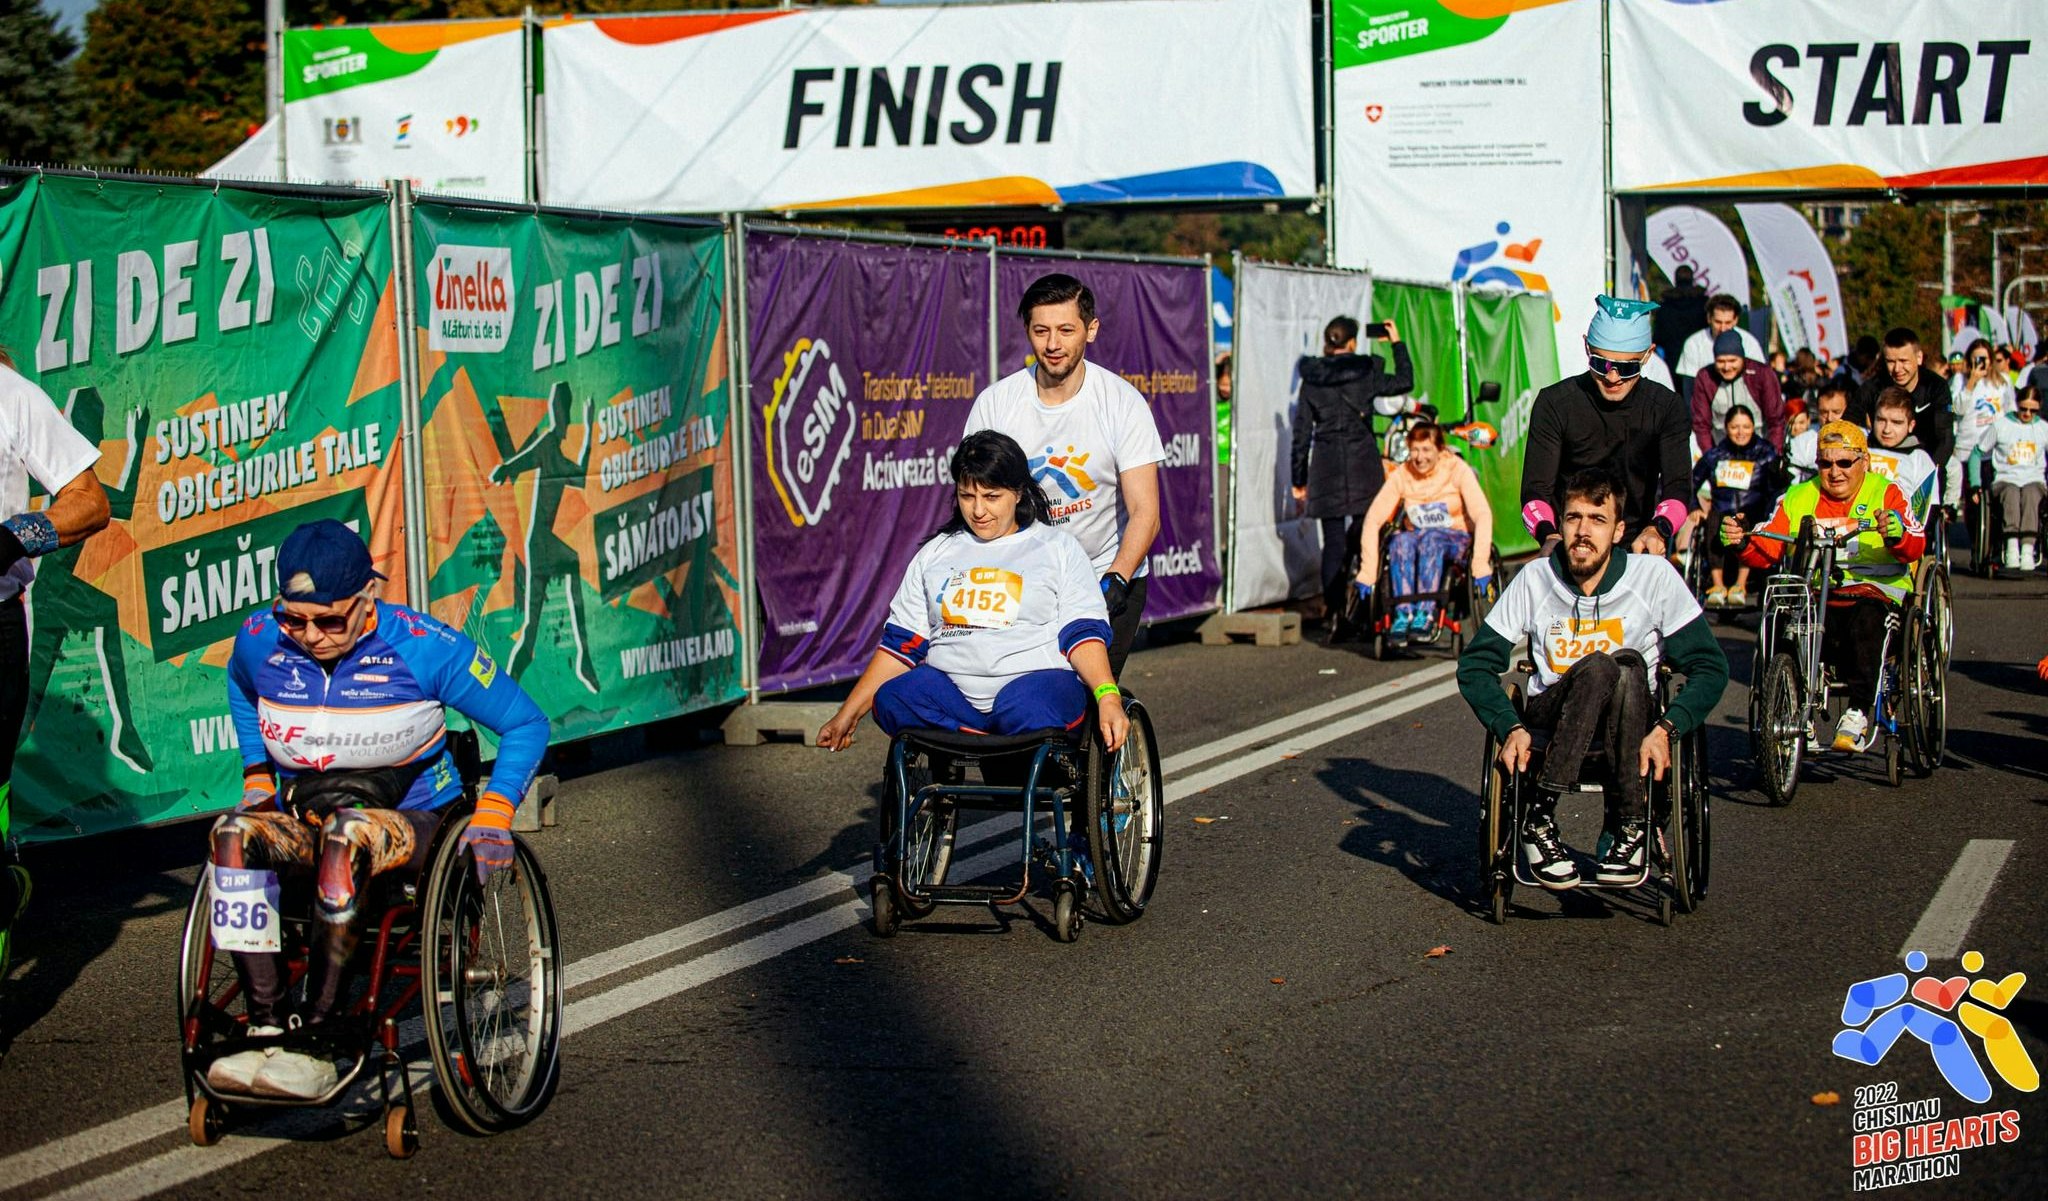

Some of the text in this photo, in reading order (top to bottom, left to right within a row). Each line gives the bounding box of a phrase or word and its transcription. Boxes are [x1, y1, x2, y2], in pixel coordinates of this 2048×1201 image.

[1357, 18, 1428, 49] SPORTER
[1743, 40, 2031, 127] START
[783, 62, 1062, 149] FINISH
[35, 227, 275, 373] ZI DE ZI
[533, 251, 664, 372] ZI DE ZI
[482, 320, 493, 339] de
[797, 362, 848, 484] eSIM
[1165, 432, 1200, 468] eSIM
[157, 421, 383, 524] OBICEIURILE TALE
[1049, 498, 1093, 520] HEARTS
[1417, 511, 1445, 524] 1960
[951, 587, 1008, 613] 4152
[360, 654, 394, 666] ATLAS
[1554, 637, 1612, 659] 3242
[222, 874, 251, 888] 21 KM
[213, 898, 268, 931] 836
